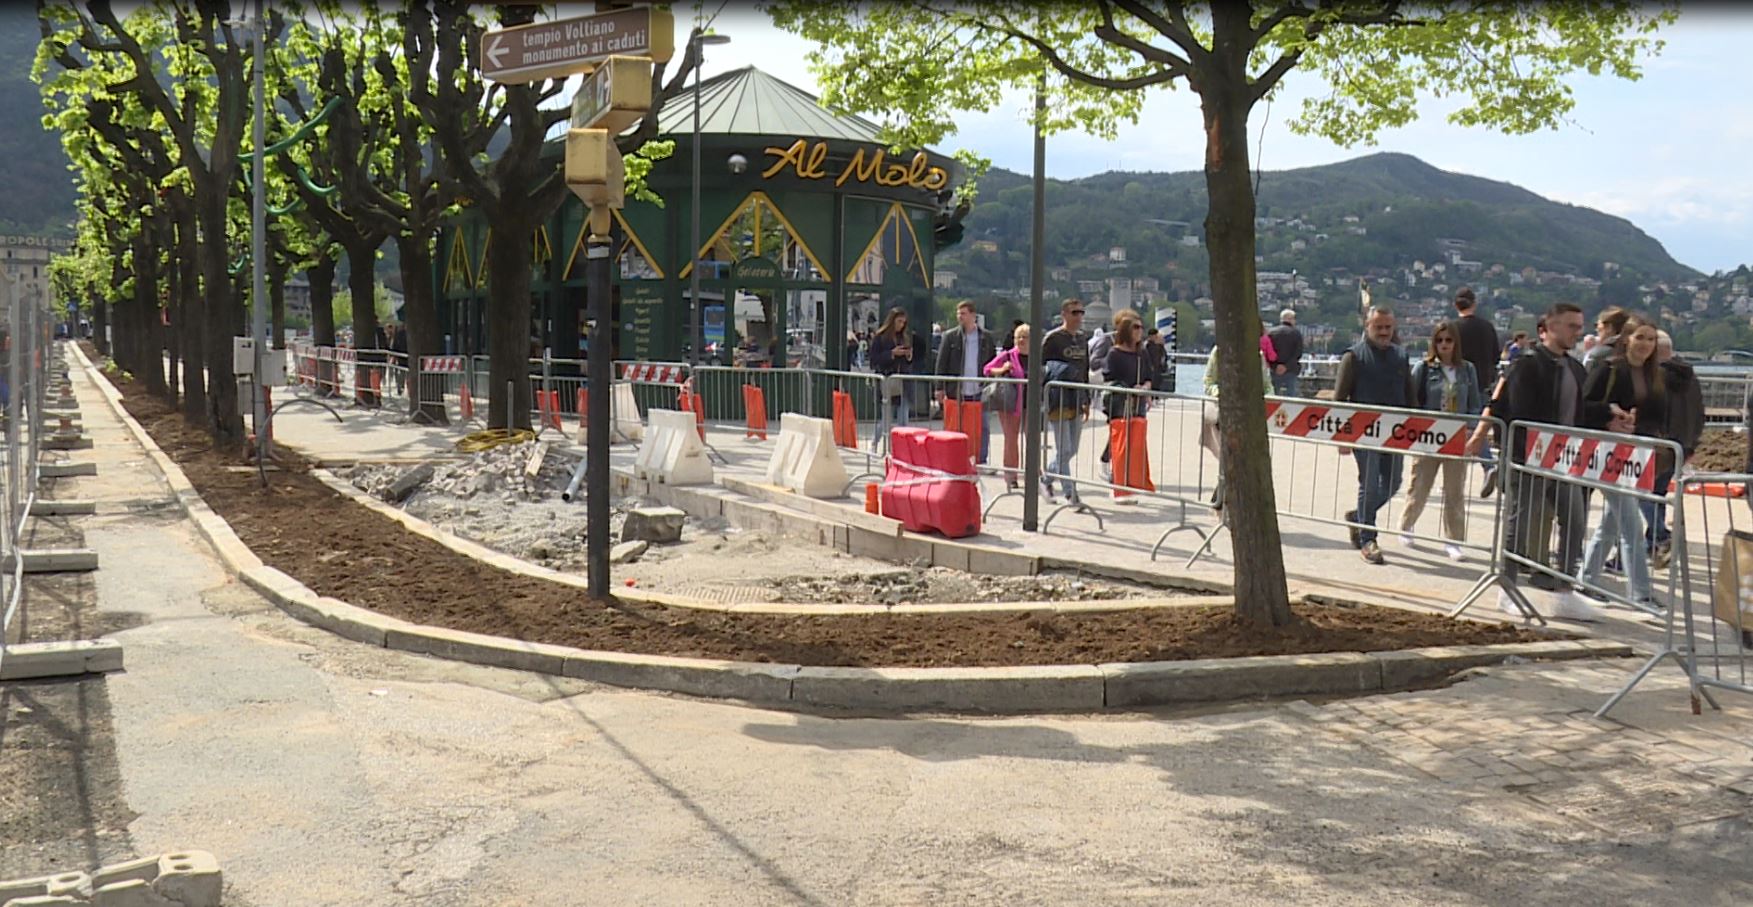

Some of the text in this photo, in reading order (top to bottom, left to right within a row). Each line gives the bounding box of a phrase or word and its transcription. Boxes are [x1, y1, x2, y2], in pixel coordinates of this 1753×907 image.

[523, 21, 615, 47] tempio Voltiano
[523, 31, 645, 64] monumento ai caduti
[762, 138, 947, 190] Al Molo
[1364, 420, 1380, 437] di
[1392, 424, 1447, 445] Como
[1588, 450, 1599, 470] di
[1605, 451, 1642, 478] Como
